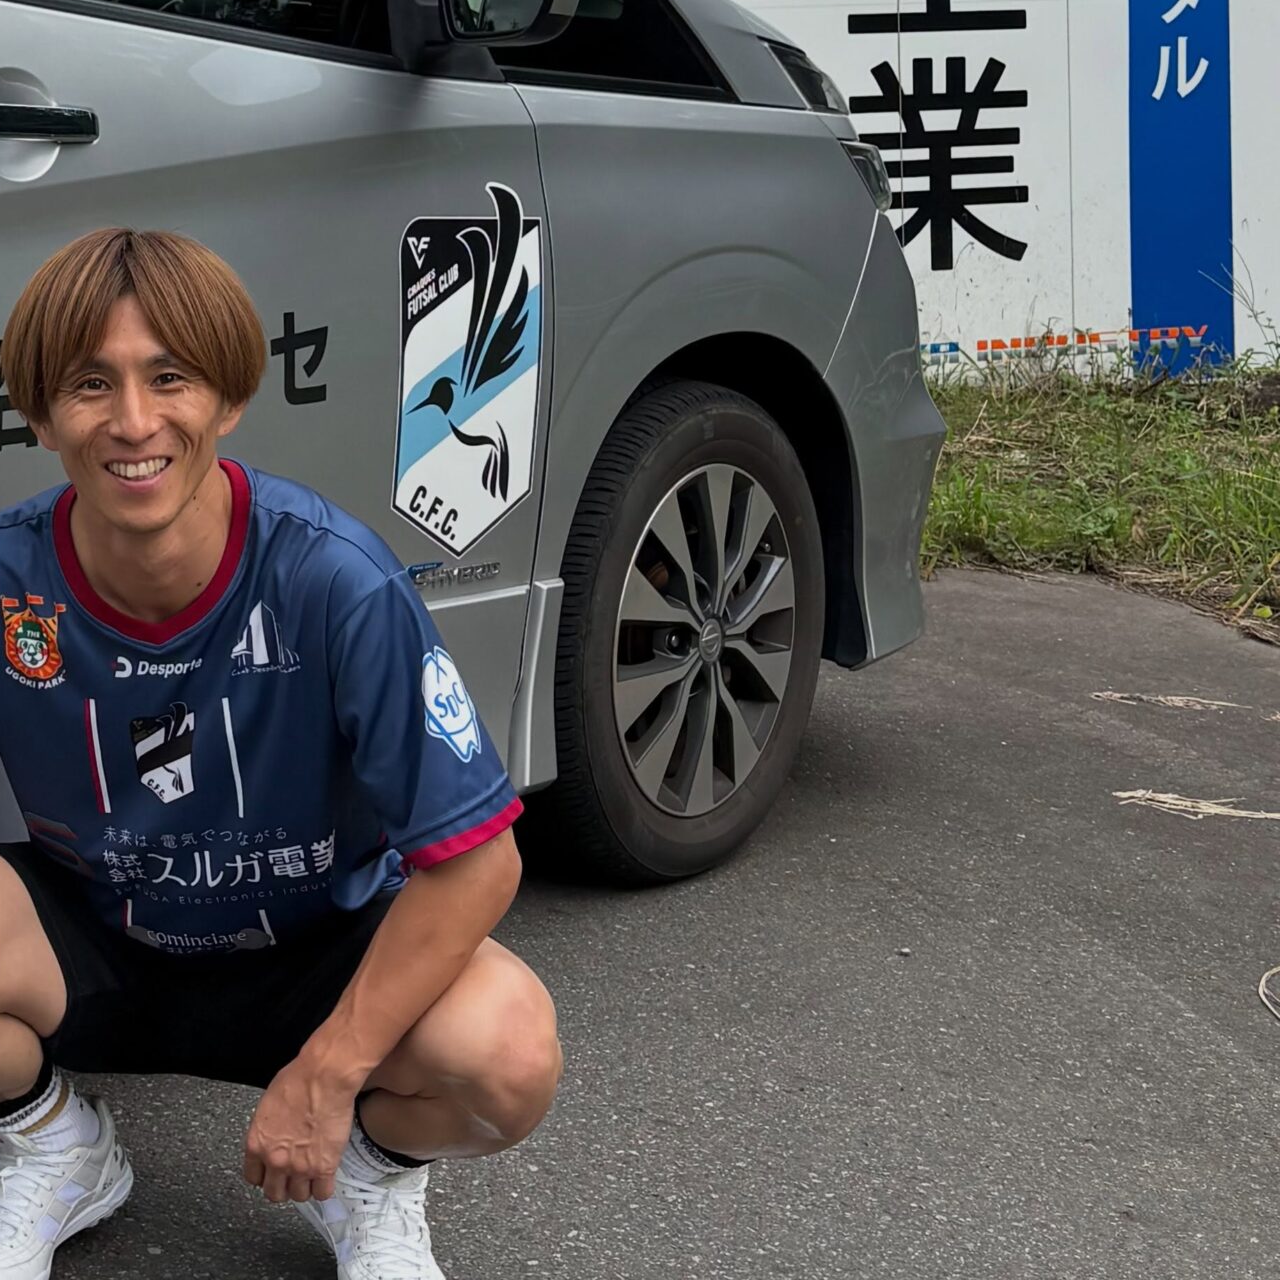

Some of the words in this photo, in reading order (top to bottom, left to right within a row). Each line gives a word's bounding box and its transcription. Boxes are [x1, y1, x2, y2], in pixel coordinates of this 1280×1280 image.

[407, 281, 438, 321] FUTSAL
[438, 262, 459, 294] CLUB
[408, 485, 459, 541] C.F.C.
[26, 629, 41, 639] THE
[5, 666, 36, 689] UGOKI
[37, 673, 66, 689] PARK
[146, 929, 248, 948] cominciare
